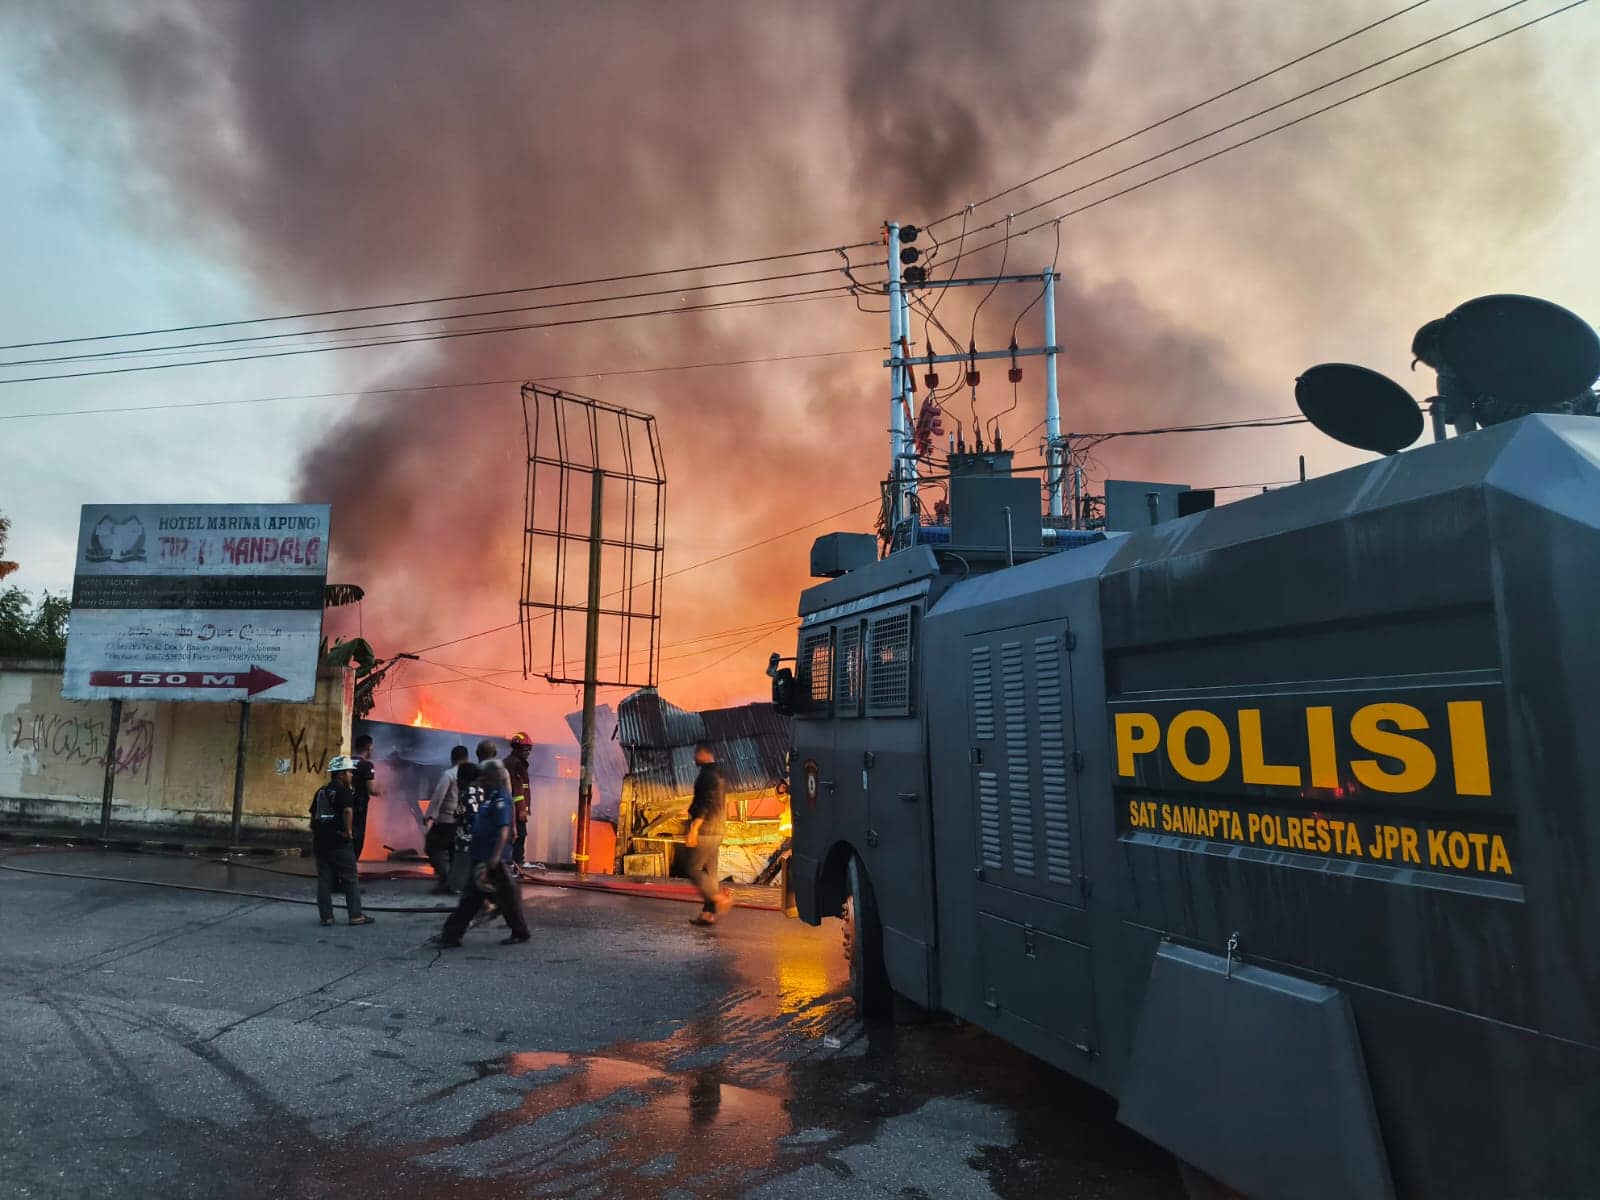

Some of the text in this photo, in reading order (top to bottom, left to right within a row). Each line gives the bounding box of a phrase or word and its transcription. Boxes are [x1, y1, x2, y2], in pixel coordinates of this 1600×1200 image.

[158, 515, 321, 530] HOTEL MARINA (APUNG)
[222, 536, 321, 565] MANDALA
[116, 673, 237, 685] 150 M
[1114, 700, 1493, 797] POLISI
[1129, 800, 1158, 827] SAT
[1161, 803, 1244, 842] SAMAPTA
[1248, 813, 1363, 857] POLRESTA
[1427, 830, 1513, 875] KOTA
